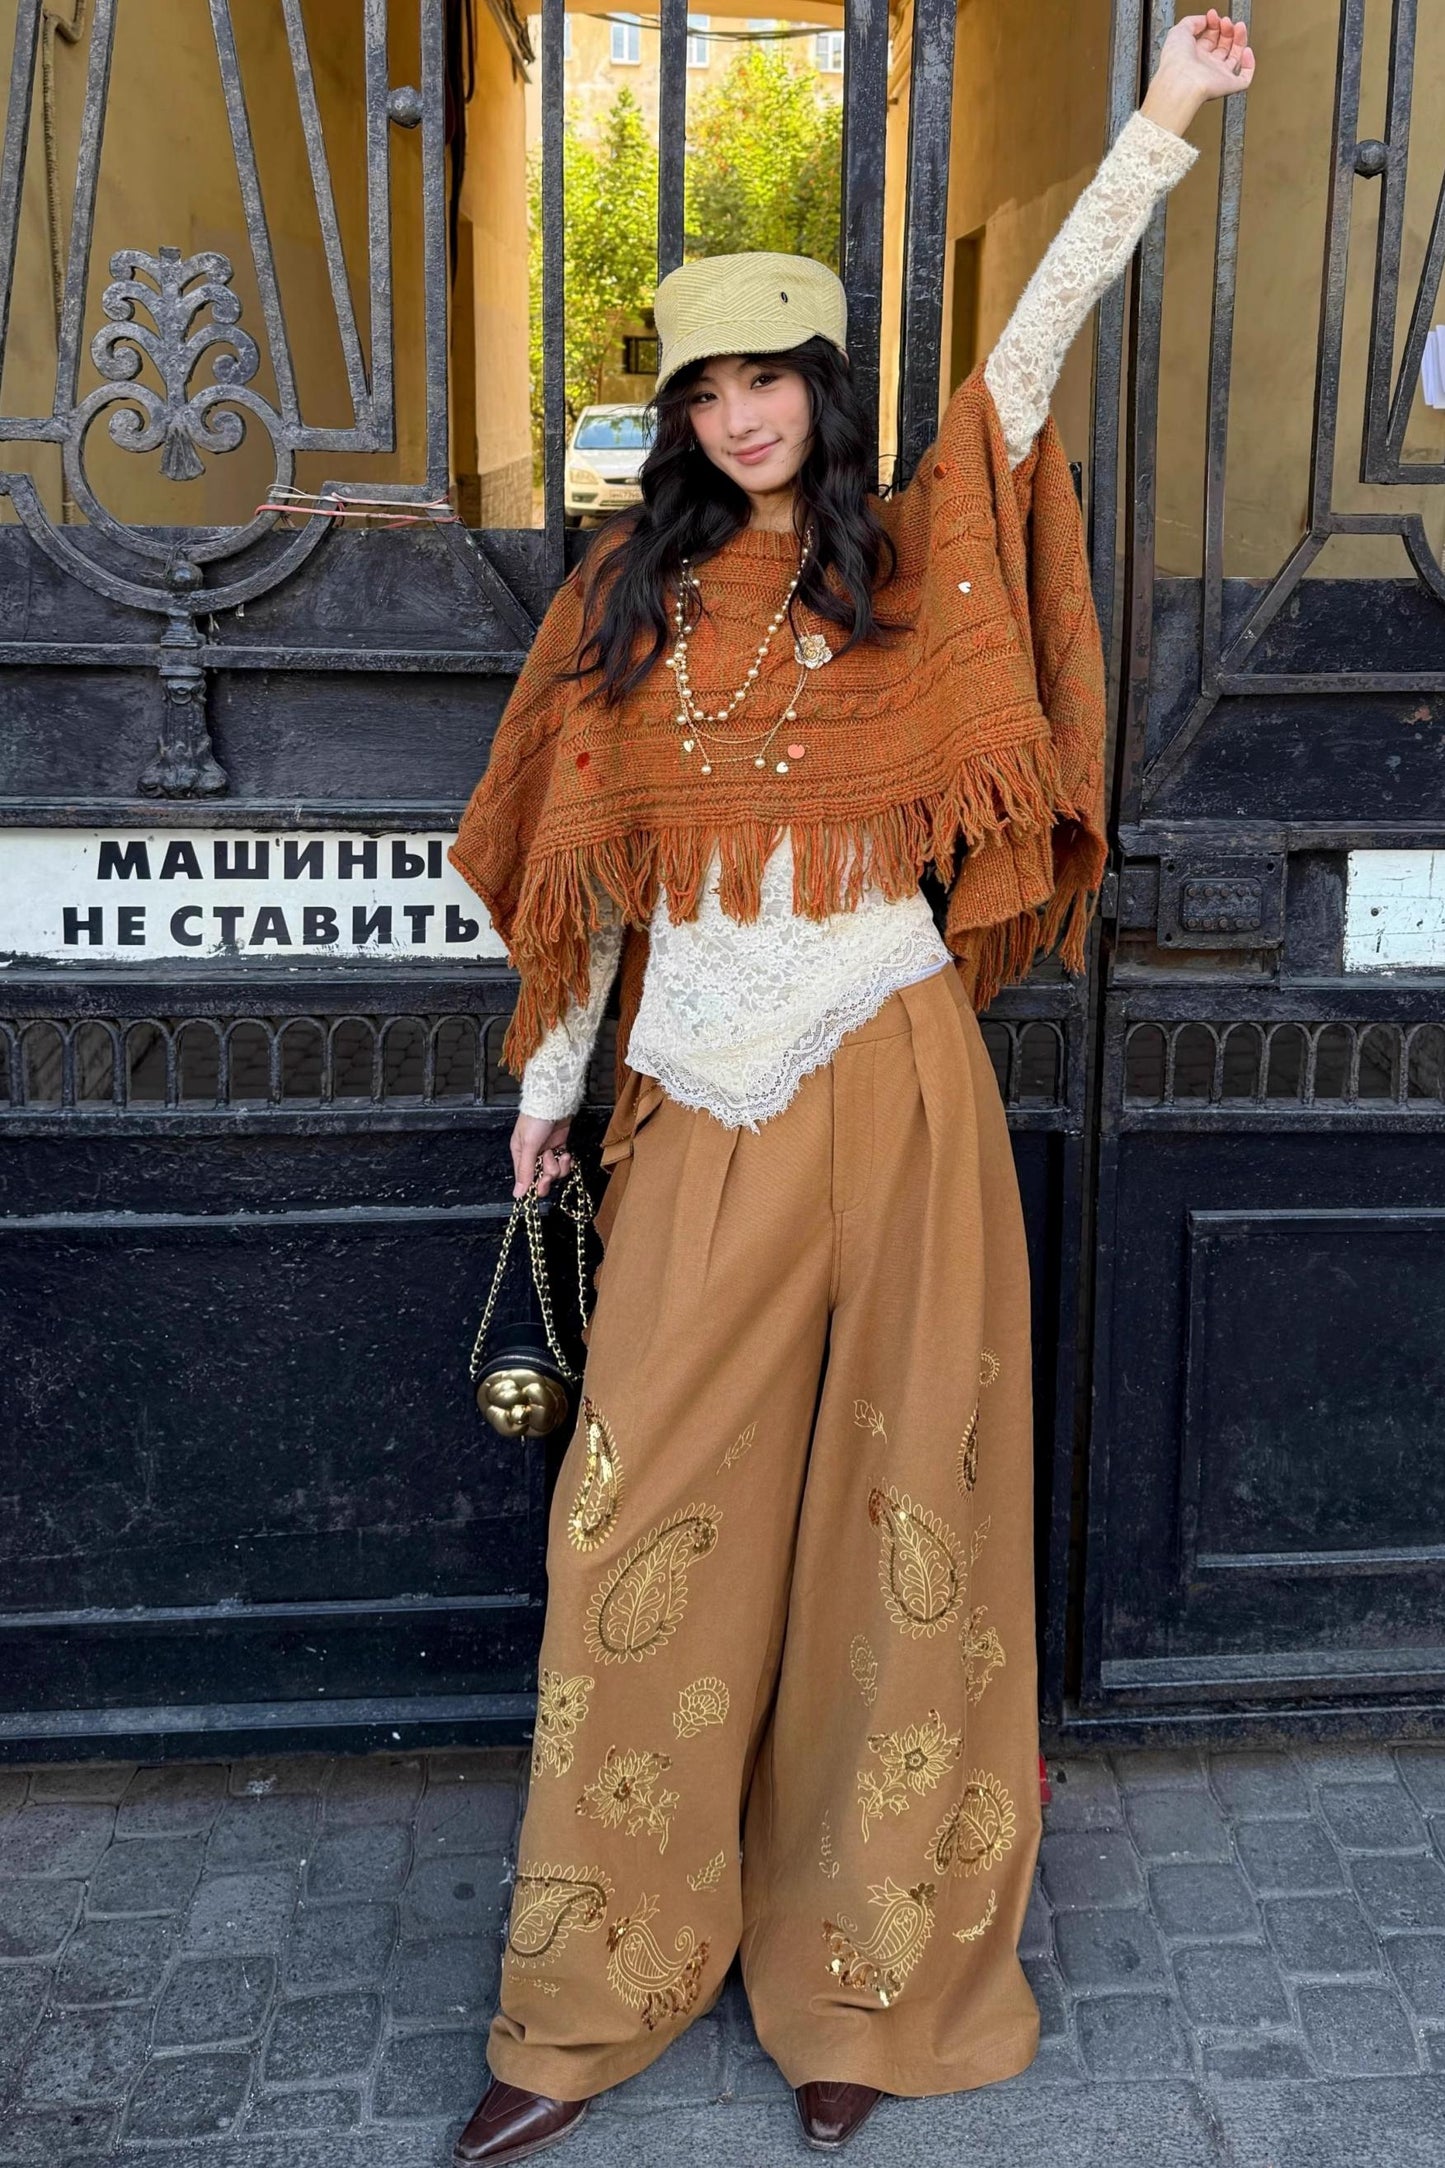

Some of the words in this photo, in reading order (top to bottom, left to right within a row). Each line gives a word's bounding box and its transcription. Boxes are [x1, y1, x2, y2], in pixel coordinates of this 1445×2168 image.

[97, 840, 442, 879] МАШИНЫ
[62, 906, 146, 945] НЕ
[170, 905, 480, 945] СТАВИТЬ
